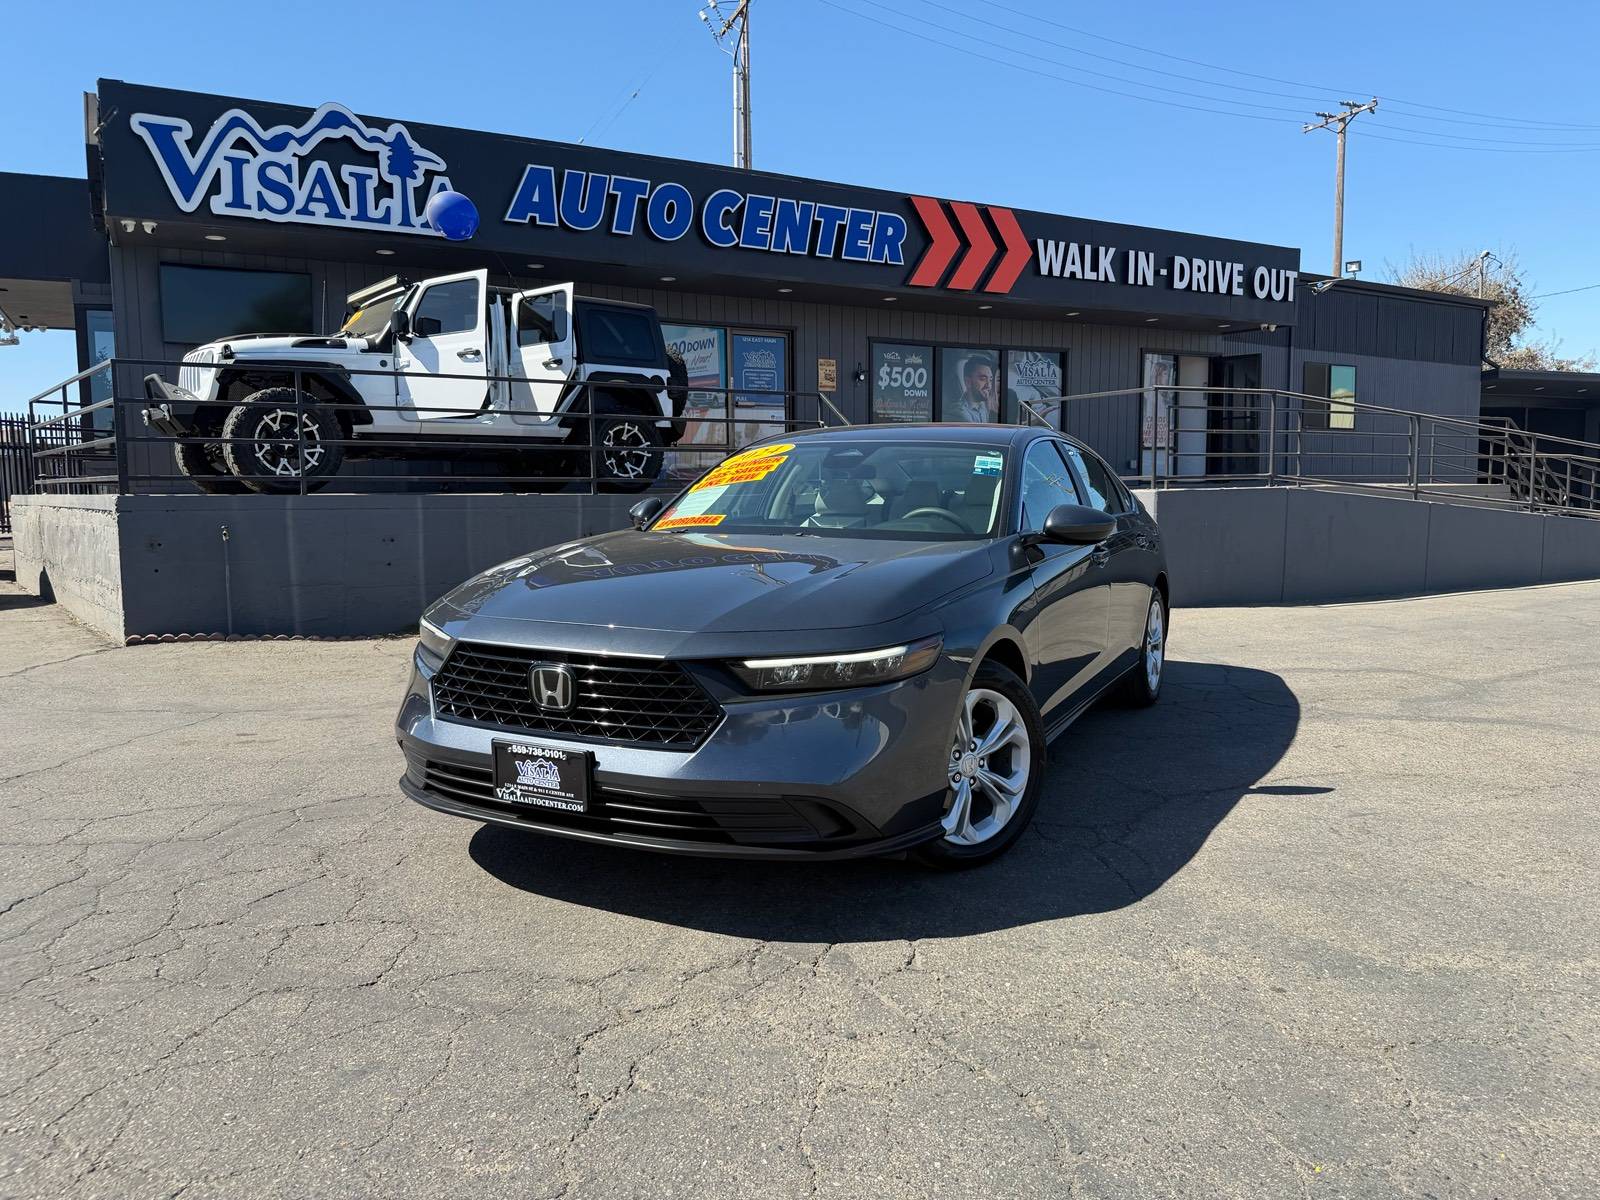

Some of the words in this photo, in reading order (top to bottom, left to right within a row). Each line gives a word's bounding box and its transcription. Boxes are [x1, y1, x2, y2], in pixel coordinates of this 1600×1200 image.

[504, 164, 694, 241] AUTO
[701, 189, 908, 265] CENTER
[1037, 238, 1117, 282] WALK
[1173, 255, 1244, 295] DRIVE
[1254, 265, 1299, 302] OUT
[687, 337, 715, 352] DOWN
[878, 363, 927, 390] $500
[1015, 359, 1057, 379] VISALIA
[904, 389, 928, 397] DOWN
[515, 758, 561, 782] VISALIA
[517, 776, 535, 785] AUTO
[535, 778, 560, 789] CENTER
[496, 786, 584, 813] VISALIAAUTOCENTER.COM
